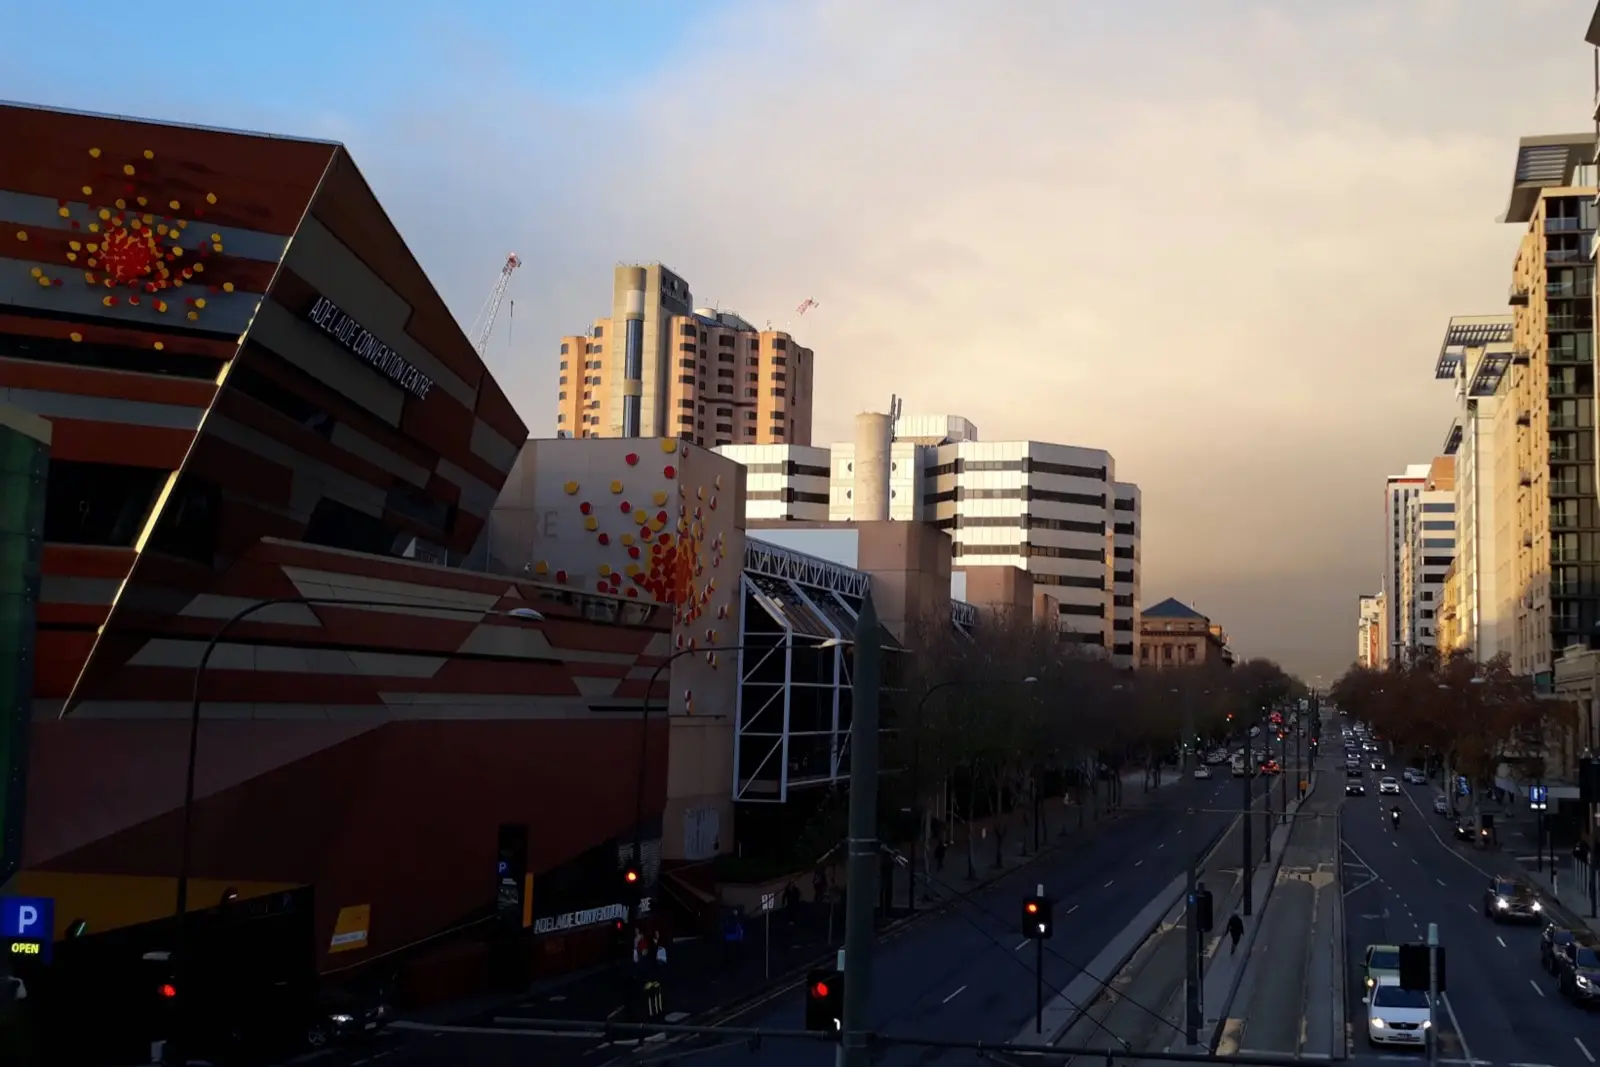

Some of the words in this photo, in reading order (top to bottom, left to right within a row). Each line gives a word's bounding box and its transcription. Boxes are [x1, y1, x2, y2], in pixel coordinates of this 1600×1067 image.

[308, 296, 360, 347] ADELAIDE
[352, 329, 406, 380] CONVENTION
[400, 364, 434, 400] CENTRE
[19, 905, 38, 934] P
[533, 911, 575, 935] ADELAIDE
[11, 943, 40, 954] OPEN
